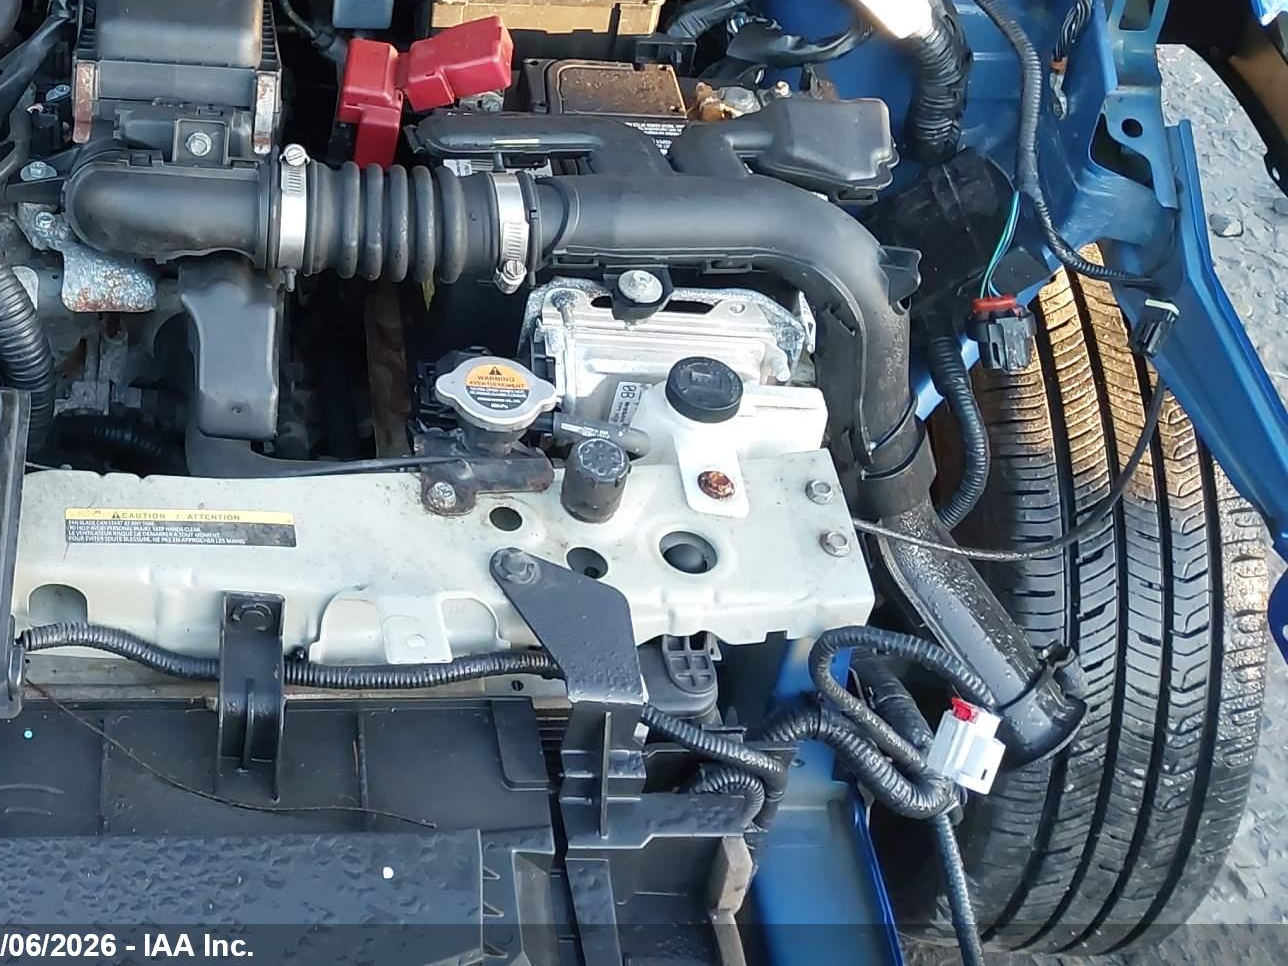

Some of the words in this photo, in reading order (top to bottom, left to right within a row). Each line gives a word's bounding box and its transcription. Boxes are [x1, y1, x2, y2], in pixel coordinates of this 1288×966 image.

[477, 375, 515, 383] WARNING
[121, 512, 166, 520] CAUTION
[187, 513, 240, 521] ATTENTION
